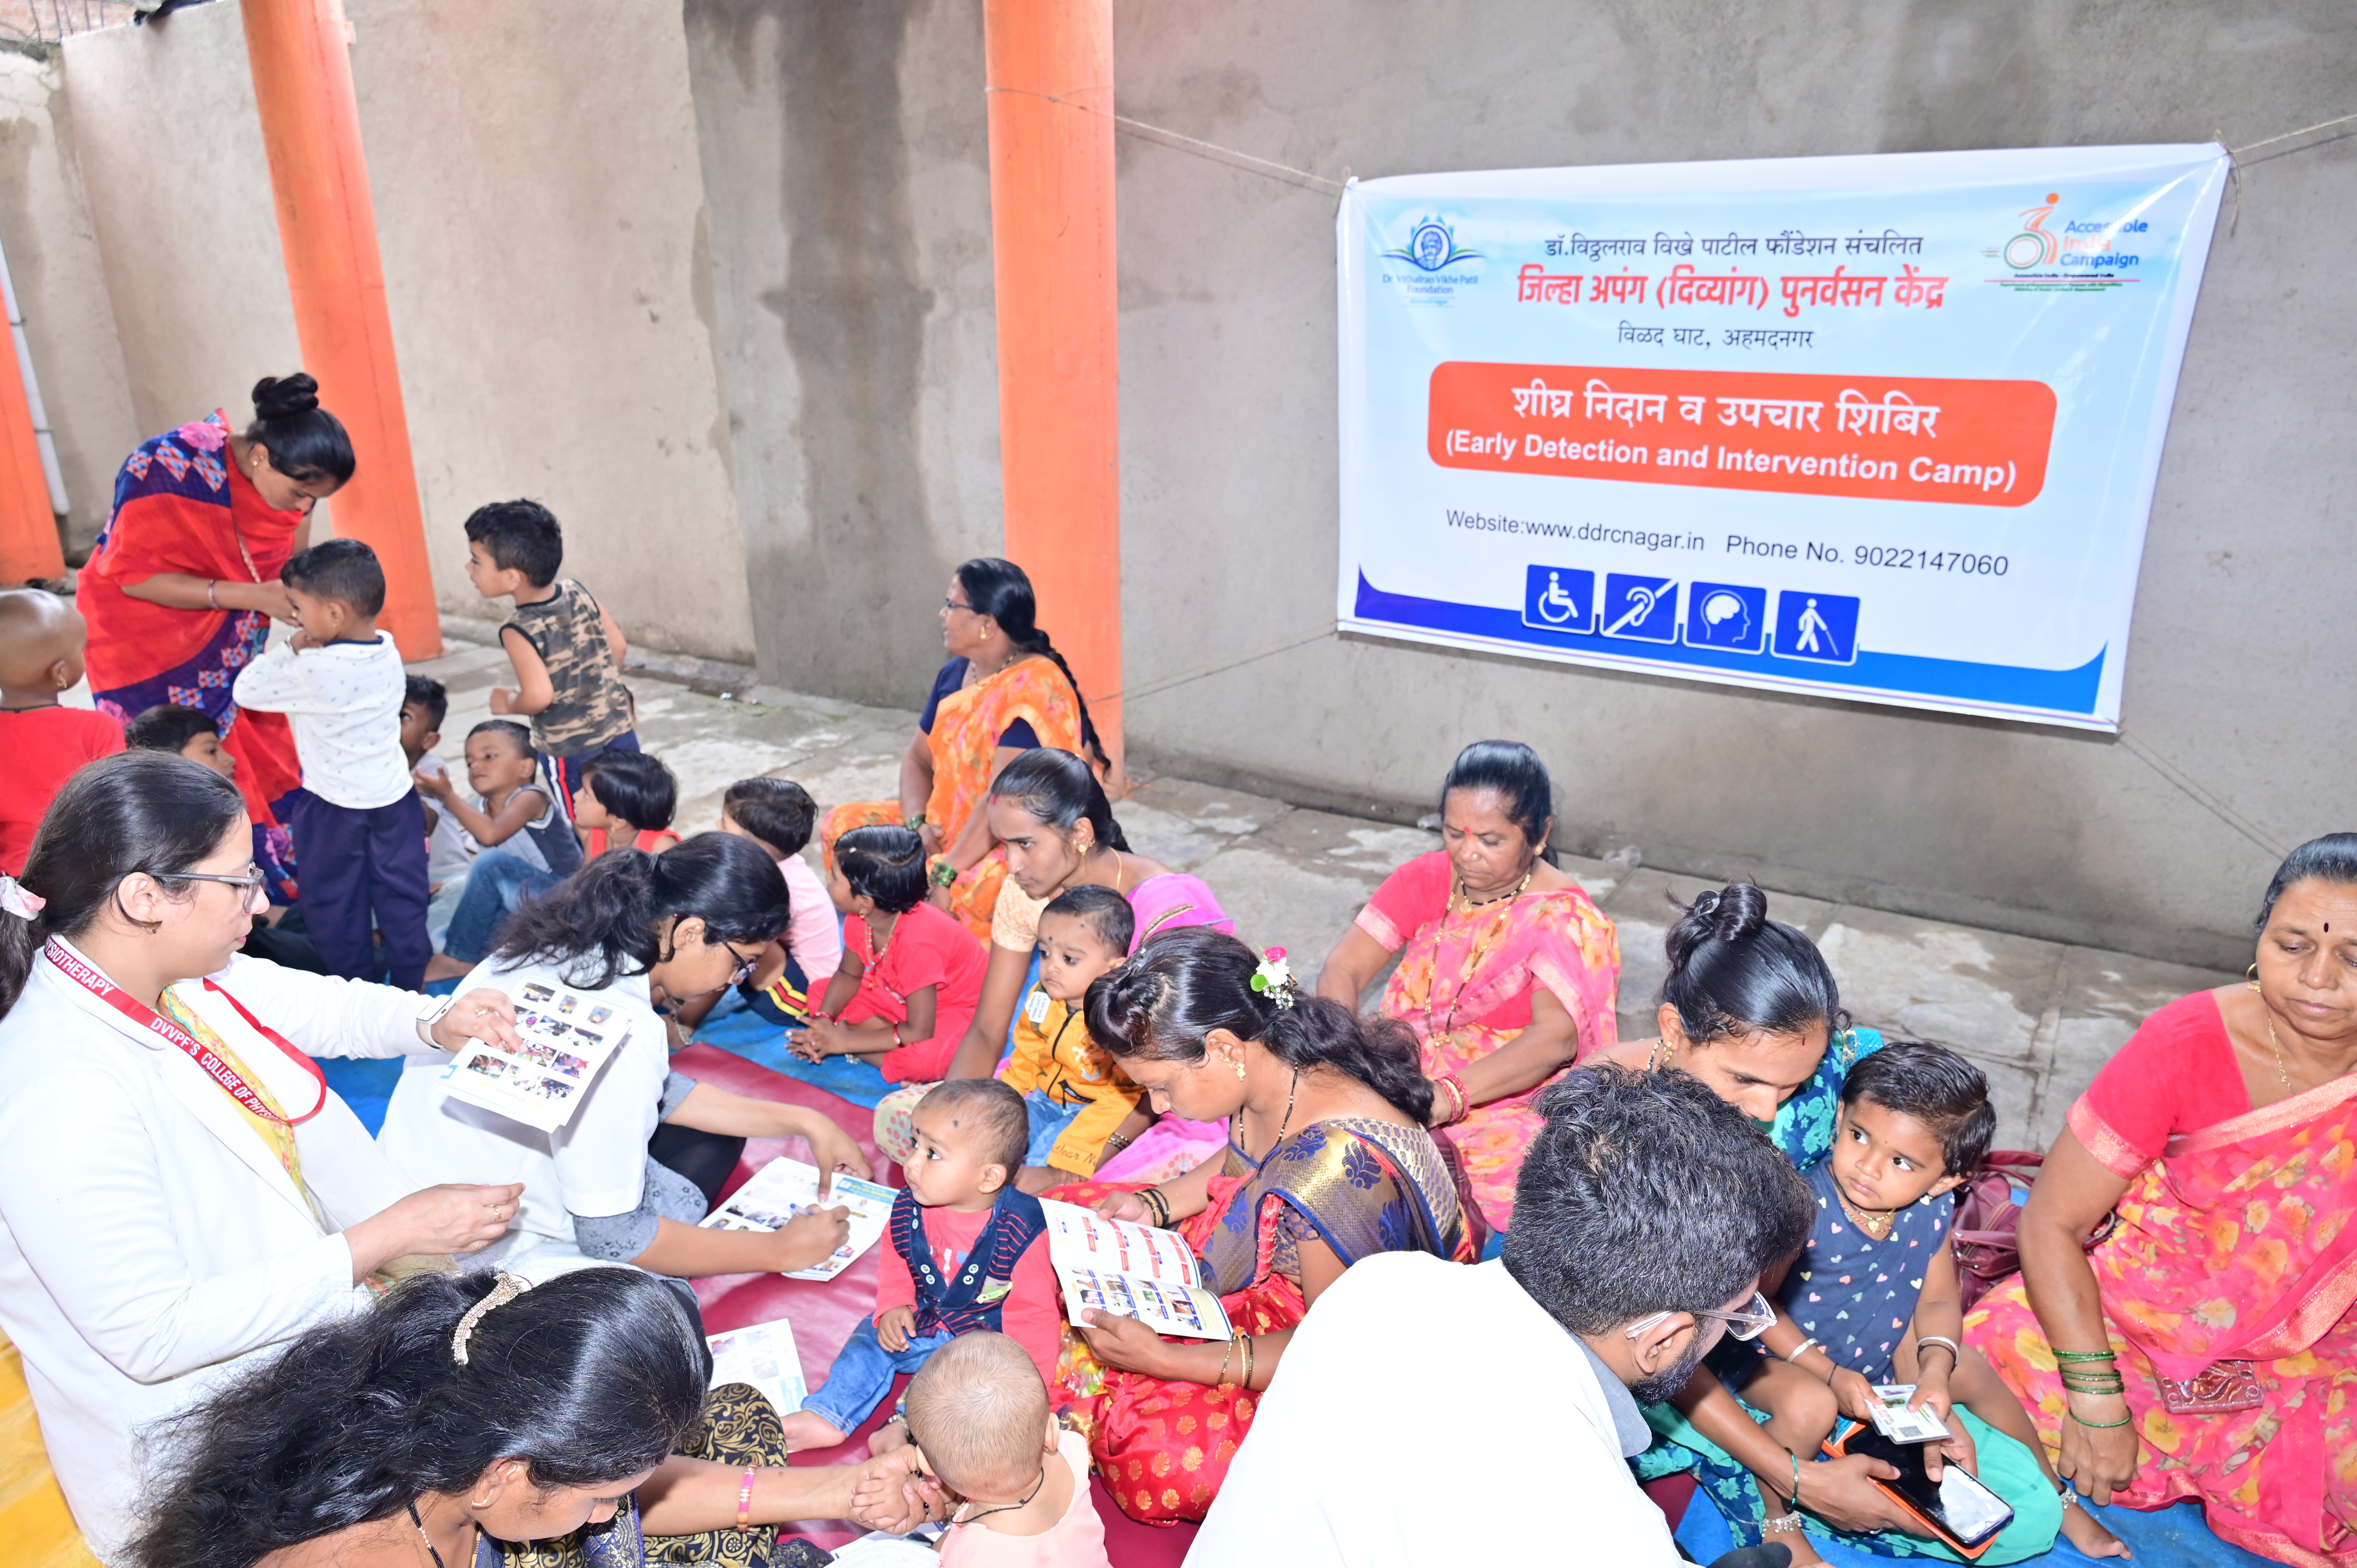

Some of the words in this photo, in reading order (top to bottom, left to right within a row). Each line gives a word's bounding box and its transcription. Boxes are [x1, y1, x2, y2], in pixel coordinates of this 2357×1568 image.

[1545, 233, 1645, 261] डॉ.विठ्ठलराव
[1655, 232, 1693, 255] विखे
[1702, 233, 1758, 255] पाटील
[1766, 231, 1836, 255] फौंडेशन
[1846, 230, 1922, 254] संचलित
[2065, 219, 2149, 234] Acceble
[2060, 253, 2140, 269] Campaign
[1407, 285, 1454, 294] Foundation
[1518, 264, 1583, 304] जिल्हा
[1590, 267, 1648, 304] अपंग
[1657, 265, 1768, 310] (दिव्यांग)
[1781, 266, 1887, 317] पुनर्वसन
[1895, 264, 1948, 309] केंद्र
[1618, 321, 1664, 346] विळद
[1674, 329, 1710, 348] घाट,
[1723, 330, 1813, 349] अहमदनगर
[1512, 378, 1573, 417] शीघ्र
[1583, 379, 1668, 427] निदान
[1678, 396, 1705, 424] व
[1716, 398, 1823, 432] उपचार
[1835, 389, 1940, 438] शिबिर
[1447, 430, 1516, 460] (Early
[1525, 433, 1647, 464] Detection
[1657, 445, 1708, 468] and
[1718, 447, 1897, 480] Intervention
[1909, 457, 2015, 493] Camp)
[1447, 510, 1703, 551] Website:www.ddrcnagar.in
[1727, 535, 1797, 558] Phone
[1807, 542, 1843, 562] No.
[1855, 546, 2008, 575] 9022147060
[150, 1018, 201, 1056] DVVPF'S
[201, 1053, 241, 1092] COLLEGE
[234, 1085, 253, 1103] OF
